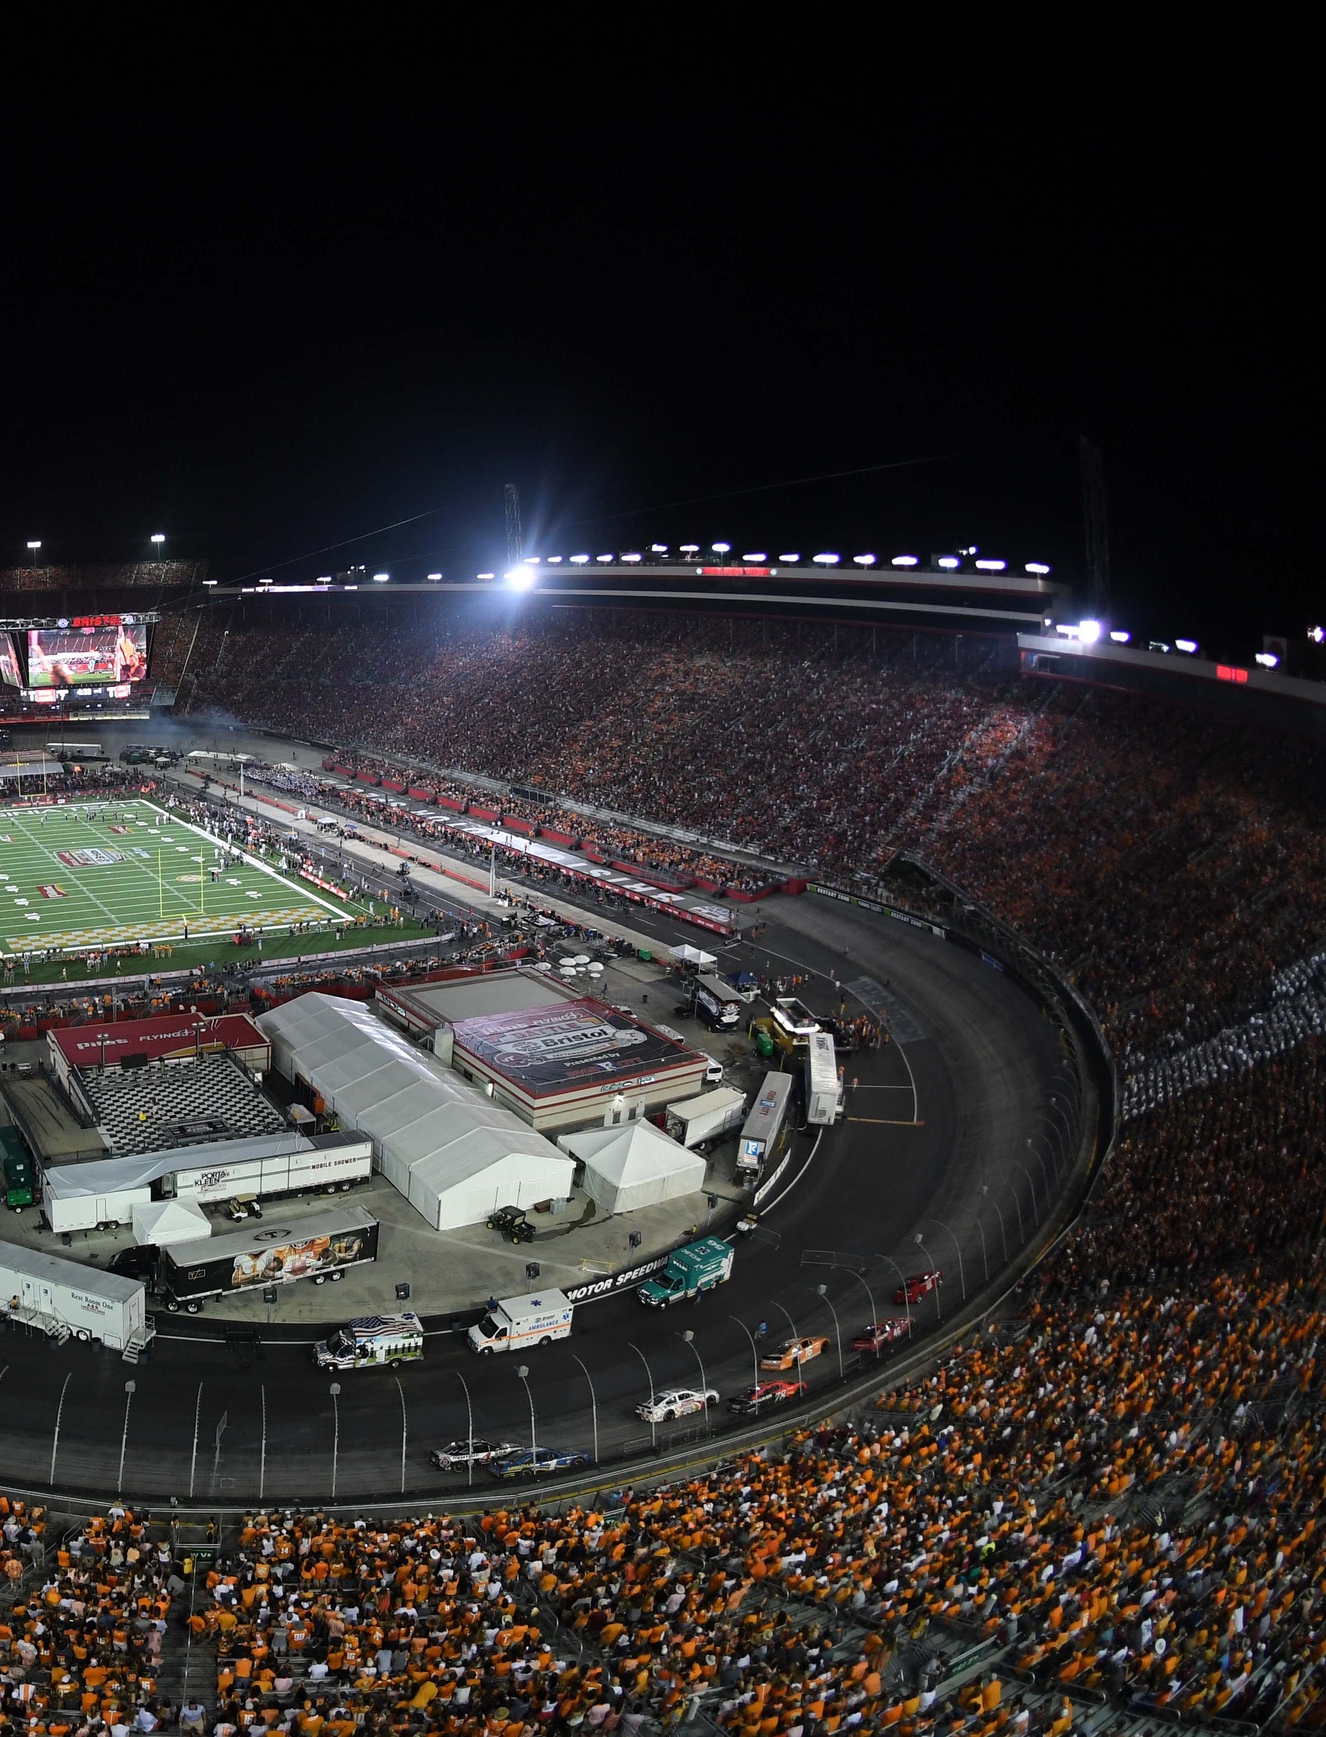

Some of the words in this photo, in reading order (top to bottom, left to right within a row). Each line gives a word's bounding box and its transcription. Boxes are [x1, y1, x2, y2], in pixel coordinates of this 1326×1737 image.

[73, 616, 122, 627] BRISTOL
[139, 1031, 181, 1042] FLYING
[513, 1022, 578, 1039] BATTLE
[540, 1029, 609, 1047] Bristol
[564, 1055, 605, 1067] Presented
[311, 1162, 332, 1170] MOBILE
[334, 1157, 357, 1167] SHOWER
[201, 1170, 224, 1179] PORTA
[194, 1178, 220, 1187] KLEEN
[567, 1279, 612, 1300] MOTOR
[616, 1255, 670, 1286] SPEEDWA
[71, 1292, 84, 1300] Rest
[84, 1295, 101, 1307] Room
[101, 1301, 114, 1311] One
[528, 1320, 559, 1331] AMBULANCE
[775, 1390, 786, 1403] 78
[481, 1452, 491, 1464] 4
[549, 1459, 557, 1471] 1
[142, 1681, 150, 1690] 16
